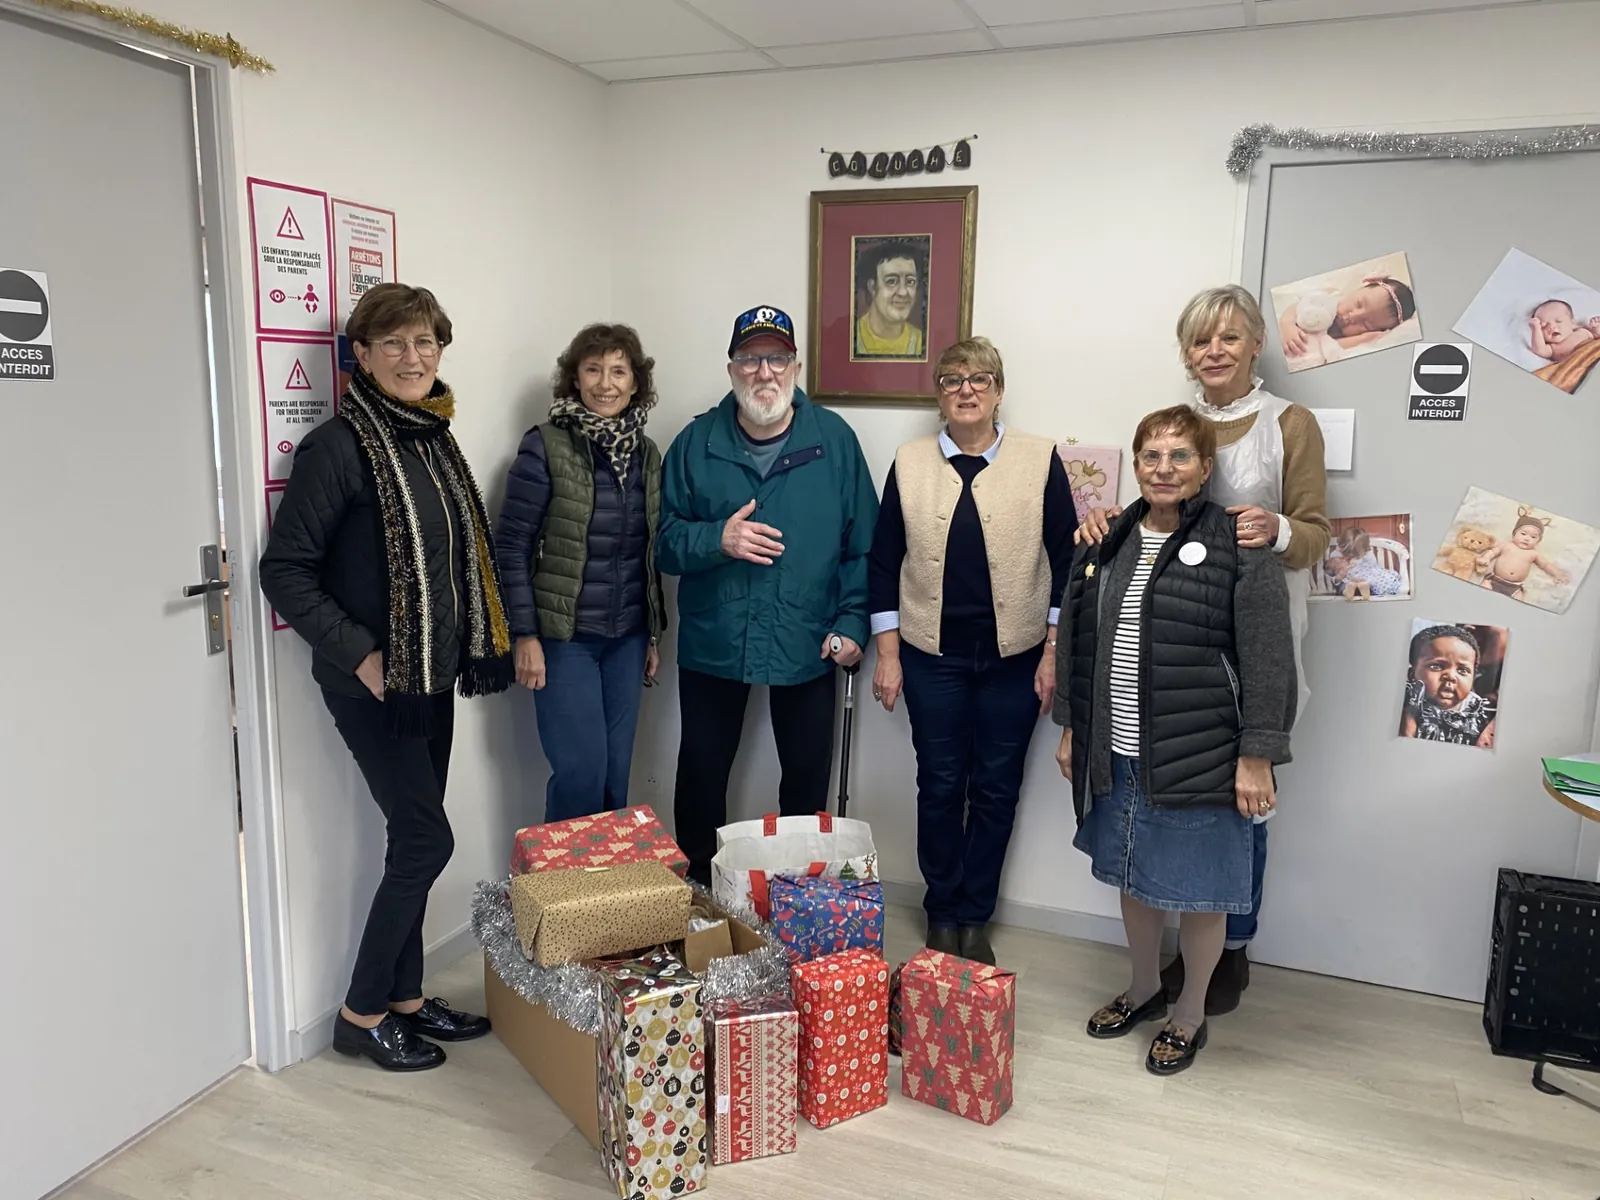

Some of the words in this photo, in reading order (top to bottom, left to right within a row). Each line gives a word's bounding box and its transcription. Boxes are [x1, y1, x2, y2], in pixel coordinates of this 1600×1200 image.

[832, 150, 963, 173] COLUCHE
[261, 245, 270, 254] LES
[270, 247, 290, 256] ENFANTS
[290, 250, 303, 258] SONT
[263, 254, 276, 263] SOUS
[276, 256, 283, 264] LA
[277, 265, 287, 273] DES
[287, 266, 308, 275] PARENTS
[351, 263, 362, 273] LES
[351, 273, 382, 285] VIOLENCES
[1, 348, 43, 360] ACCES
[0, 363, 51, 375] NTERDIT
[269, 400, 288, 408] PARENTS
[289, 400, 298, 408] ARE
[299, 400, 328, 408] RESPONSIBLE
[1419, 399, 1456, 407] ACCES
[276, 408, 286, 416] FOR
[286, 408, 300, 416] THEIR
[300, 408, 322, 416] CHILDREN
[1412, 409, 1461, 418] INTERDIT
[286, 416, 292, 424] AT
[292, 416, 301, 424] ALL
[301, 416, 315, 424] TIMES
